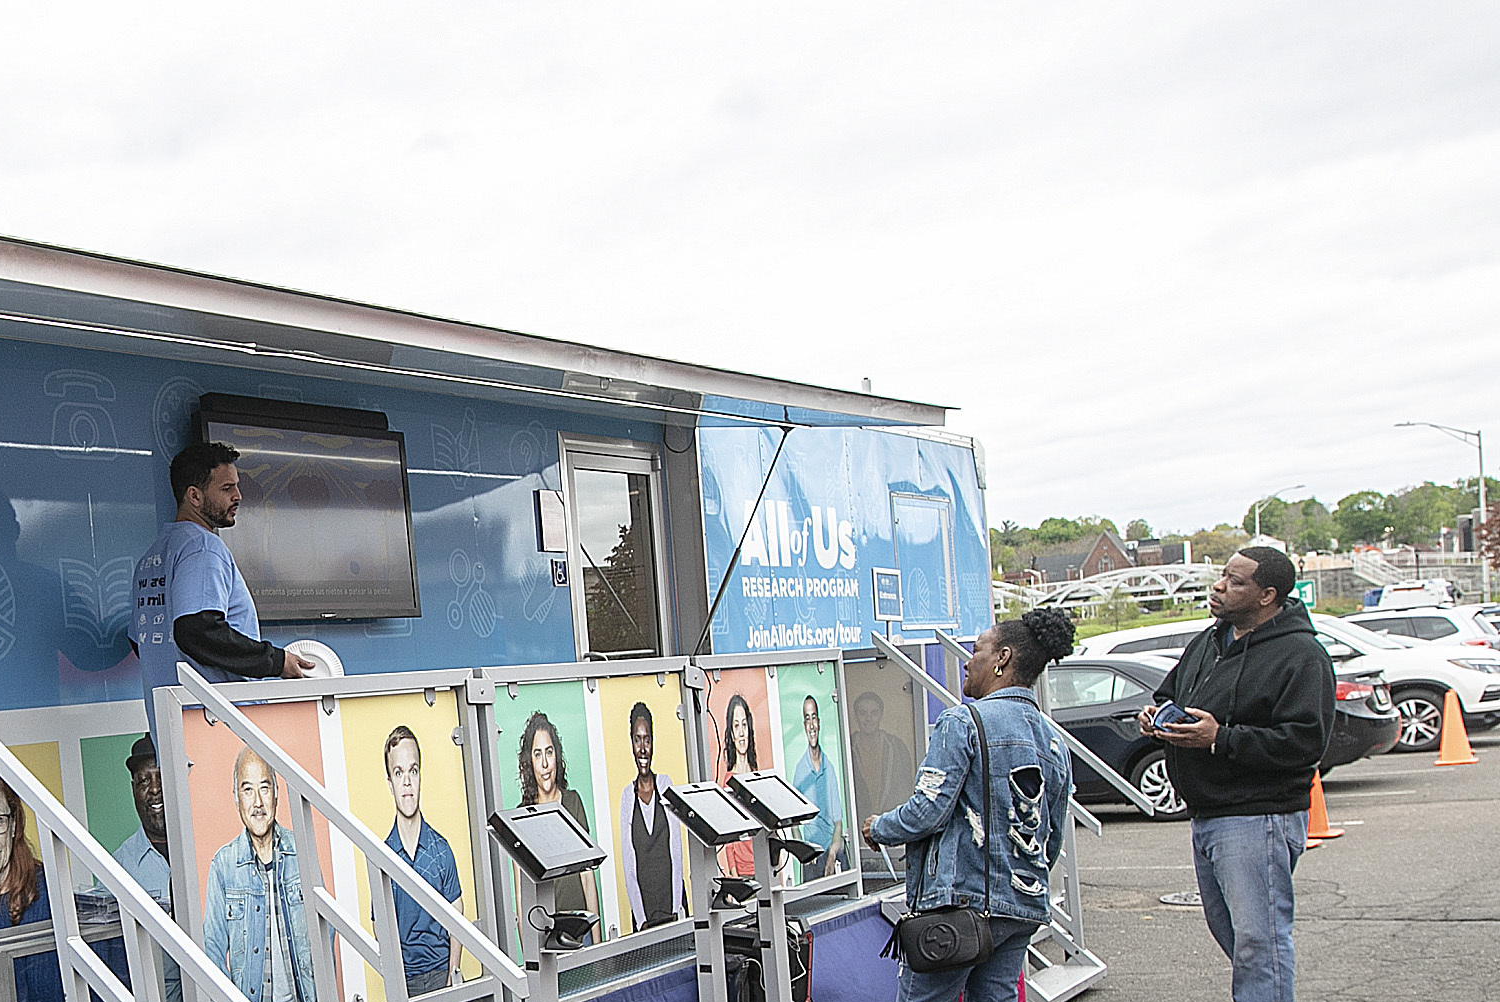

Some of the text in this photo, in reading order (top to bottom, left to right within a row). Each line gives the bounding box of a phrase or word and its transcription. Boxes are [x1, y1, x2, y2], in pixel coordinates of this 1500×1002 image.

[740, 500, 856, 570] All of Us
[742, 577, 804, 598] RESEARCH
[806, 578, 859, 598] PROGRAM
[746, 620, 861, 649] JoinAllofUs.org/tour
